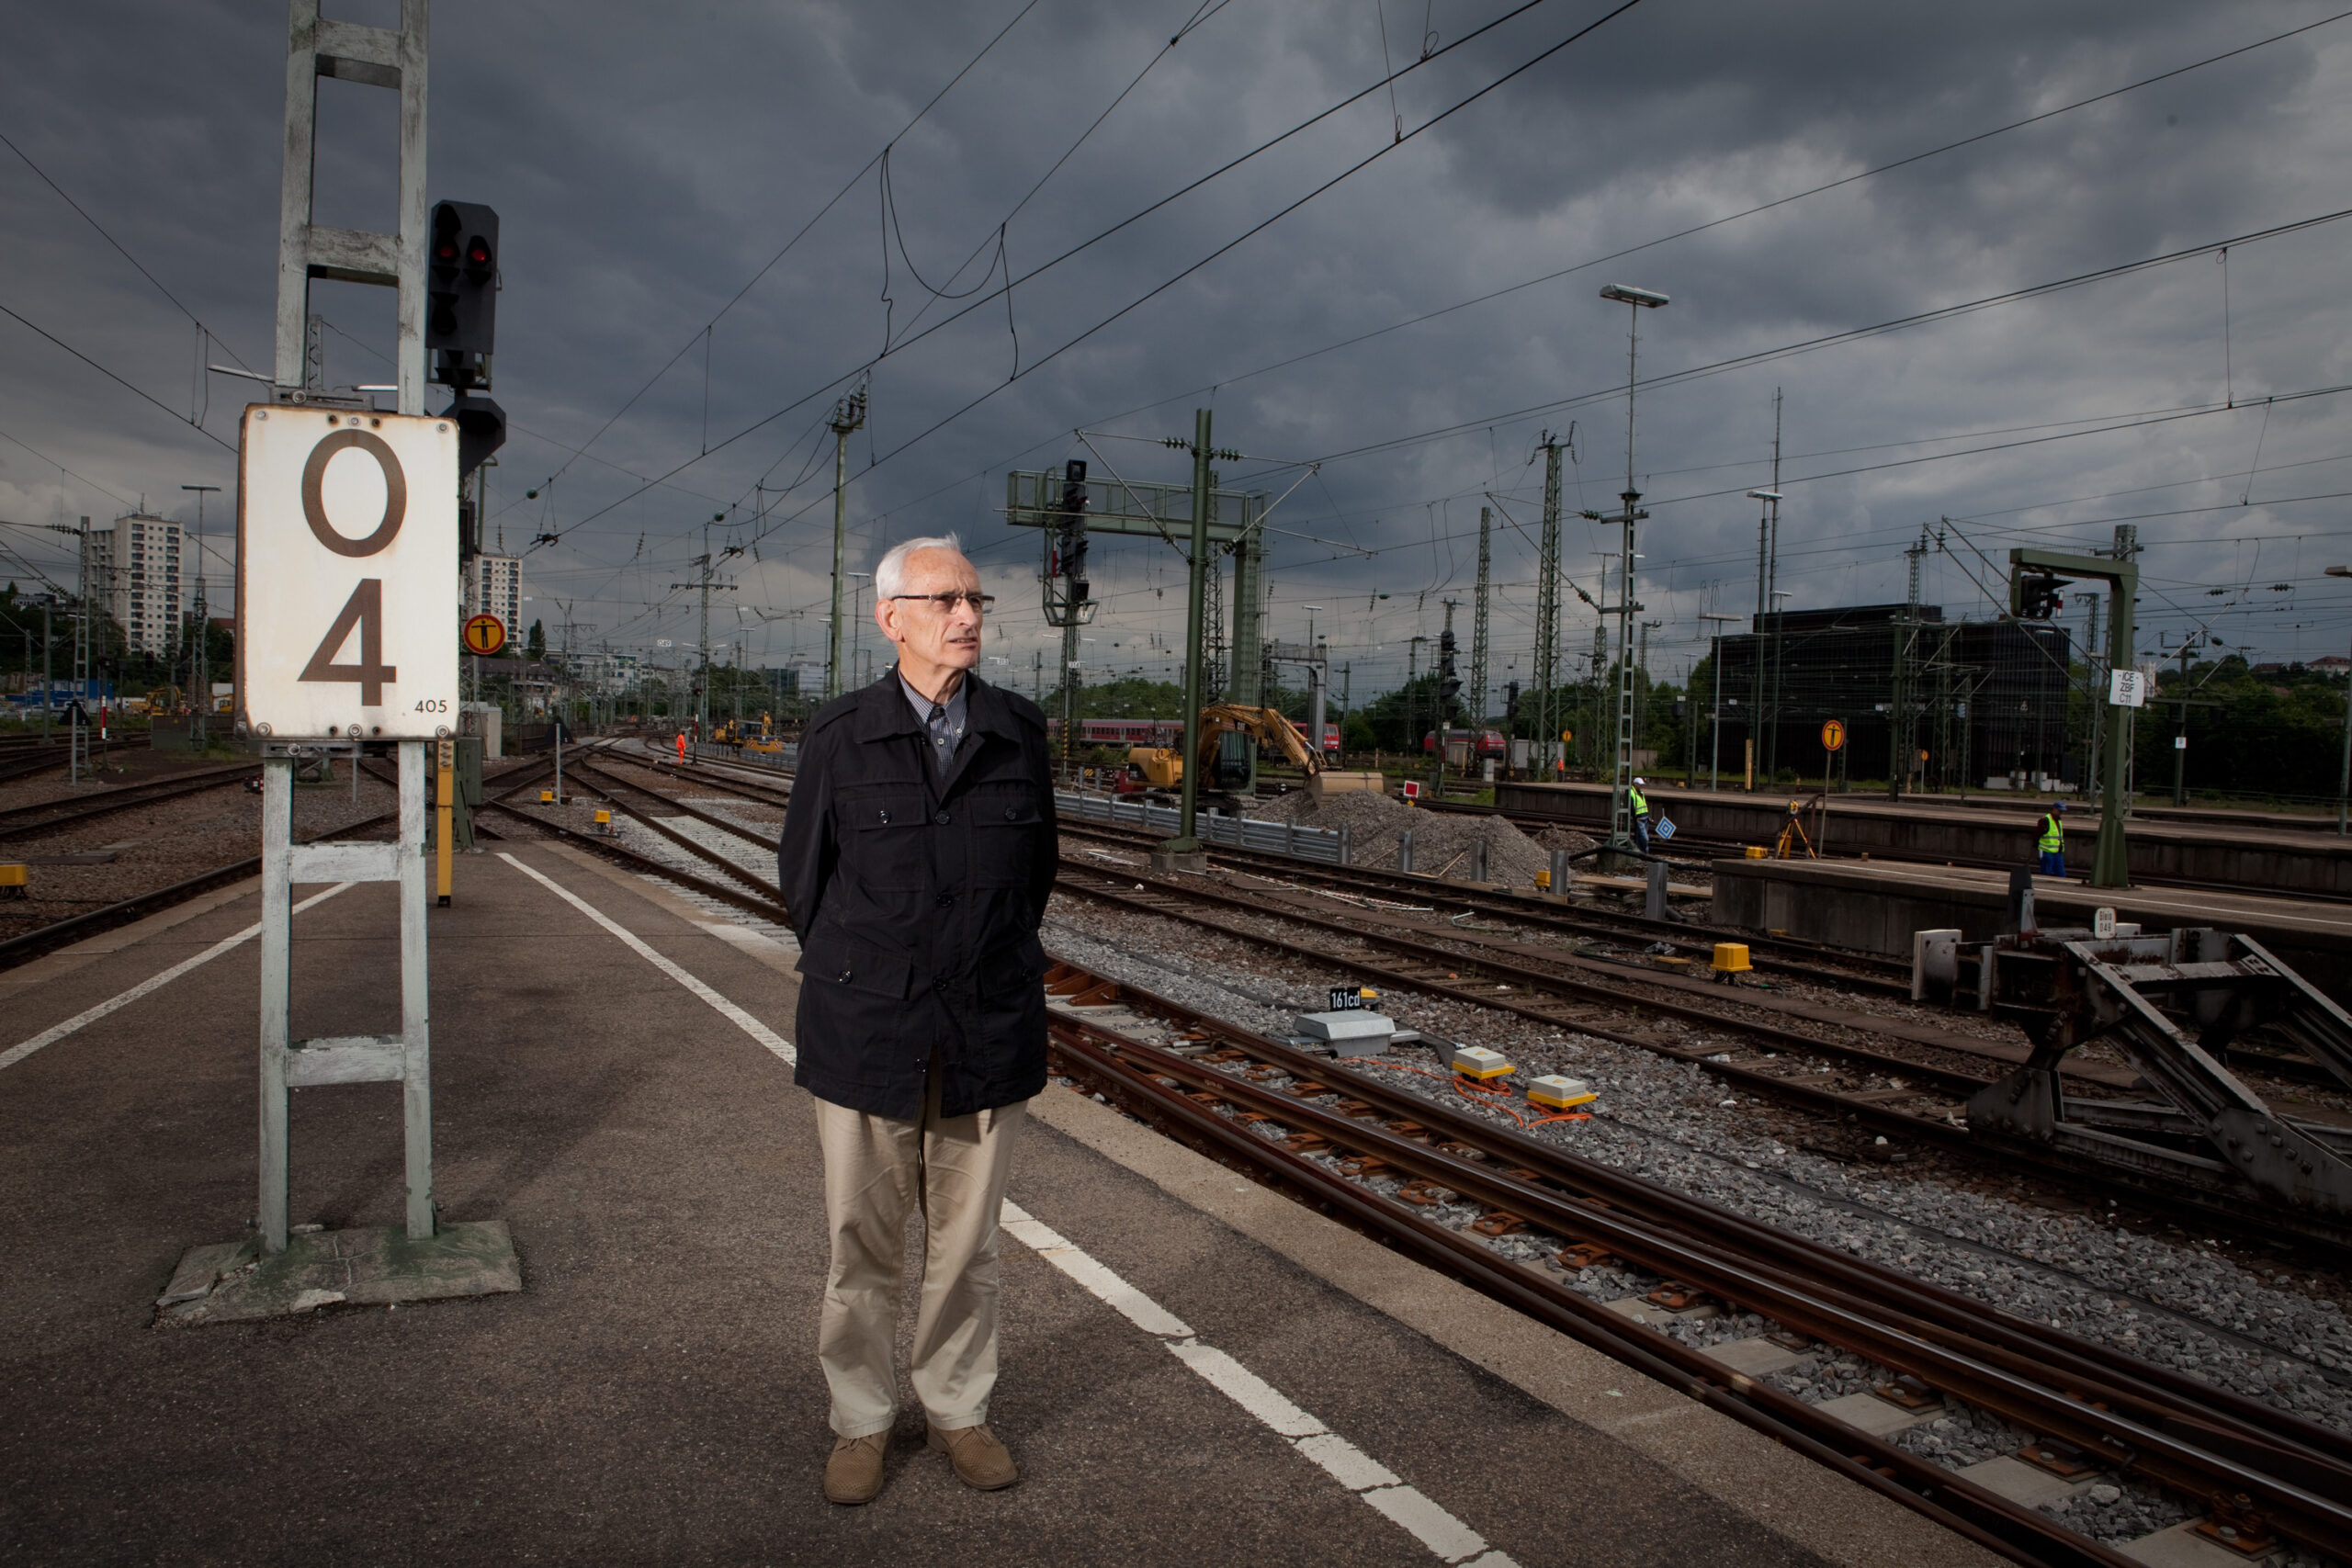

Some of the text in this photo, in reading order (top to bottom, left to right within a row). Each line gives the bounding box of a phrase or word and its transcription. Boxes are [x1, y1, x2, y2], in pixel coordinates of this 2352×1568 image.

[297, 579, 397, 707] 4
[2121, 672, 2134, 682] ICE
[2120, 682, 2134, 693] ZBF
[2119, 694, 2132, 704] C11
[414, 699, 447, 713] 405
[1331, 990, 1361, 1009] 161cd
